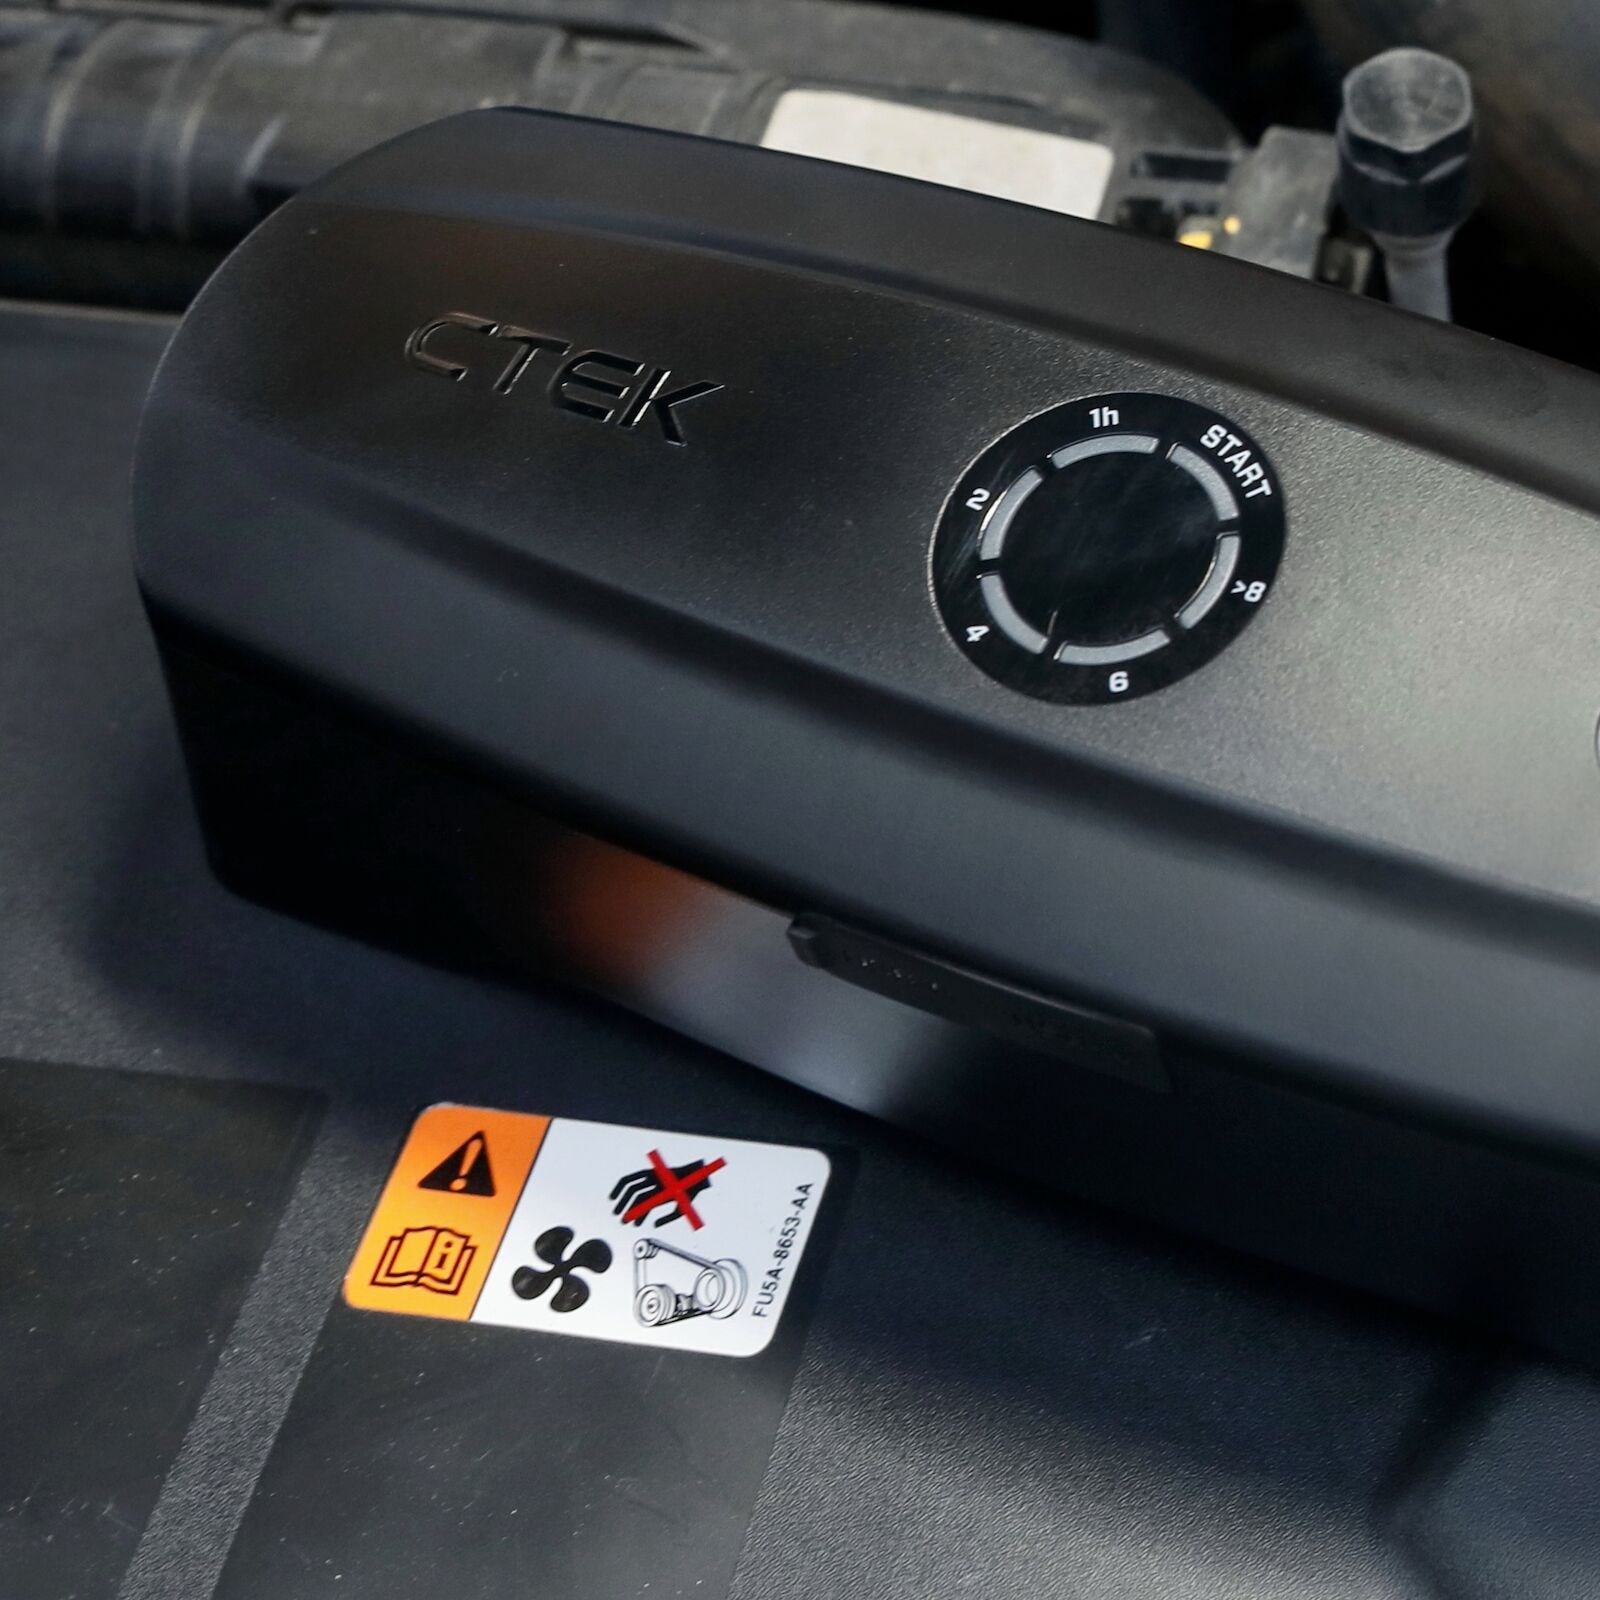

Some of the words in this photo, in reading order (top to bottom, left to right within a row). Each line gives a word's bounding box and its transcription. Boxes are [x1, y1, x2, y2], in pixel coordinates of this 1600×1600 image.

[404, 311, 725, 448] CTEK
[1089, 406, 1120, 429] 1h
[1200, 424, 1273, 500] START
[965, 488, 991, 511] 2
[965, 624, 990, 643] 4
[1108, 671, 1130, 693] 6
[752, 1182, 814, 1318] FU5A-8653-AA
